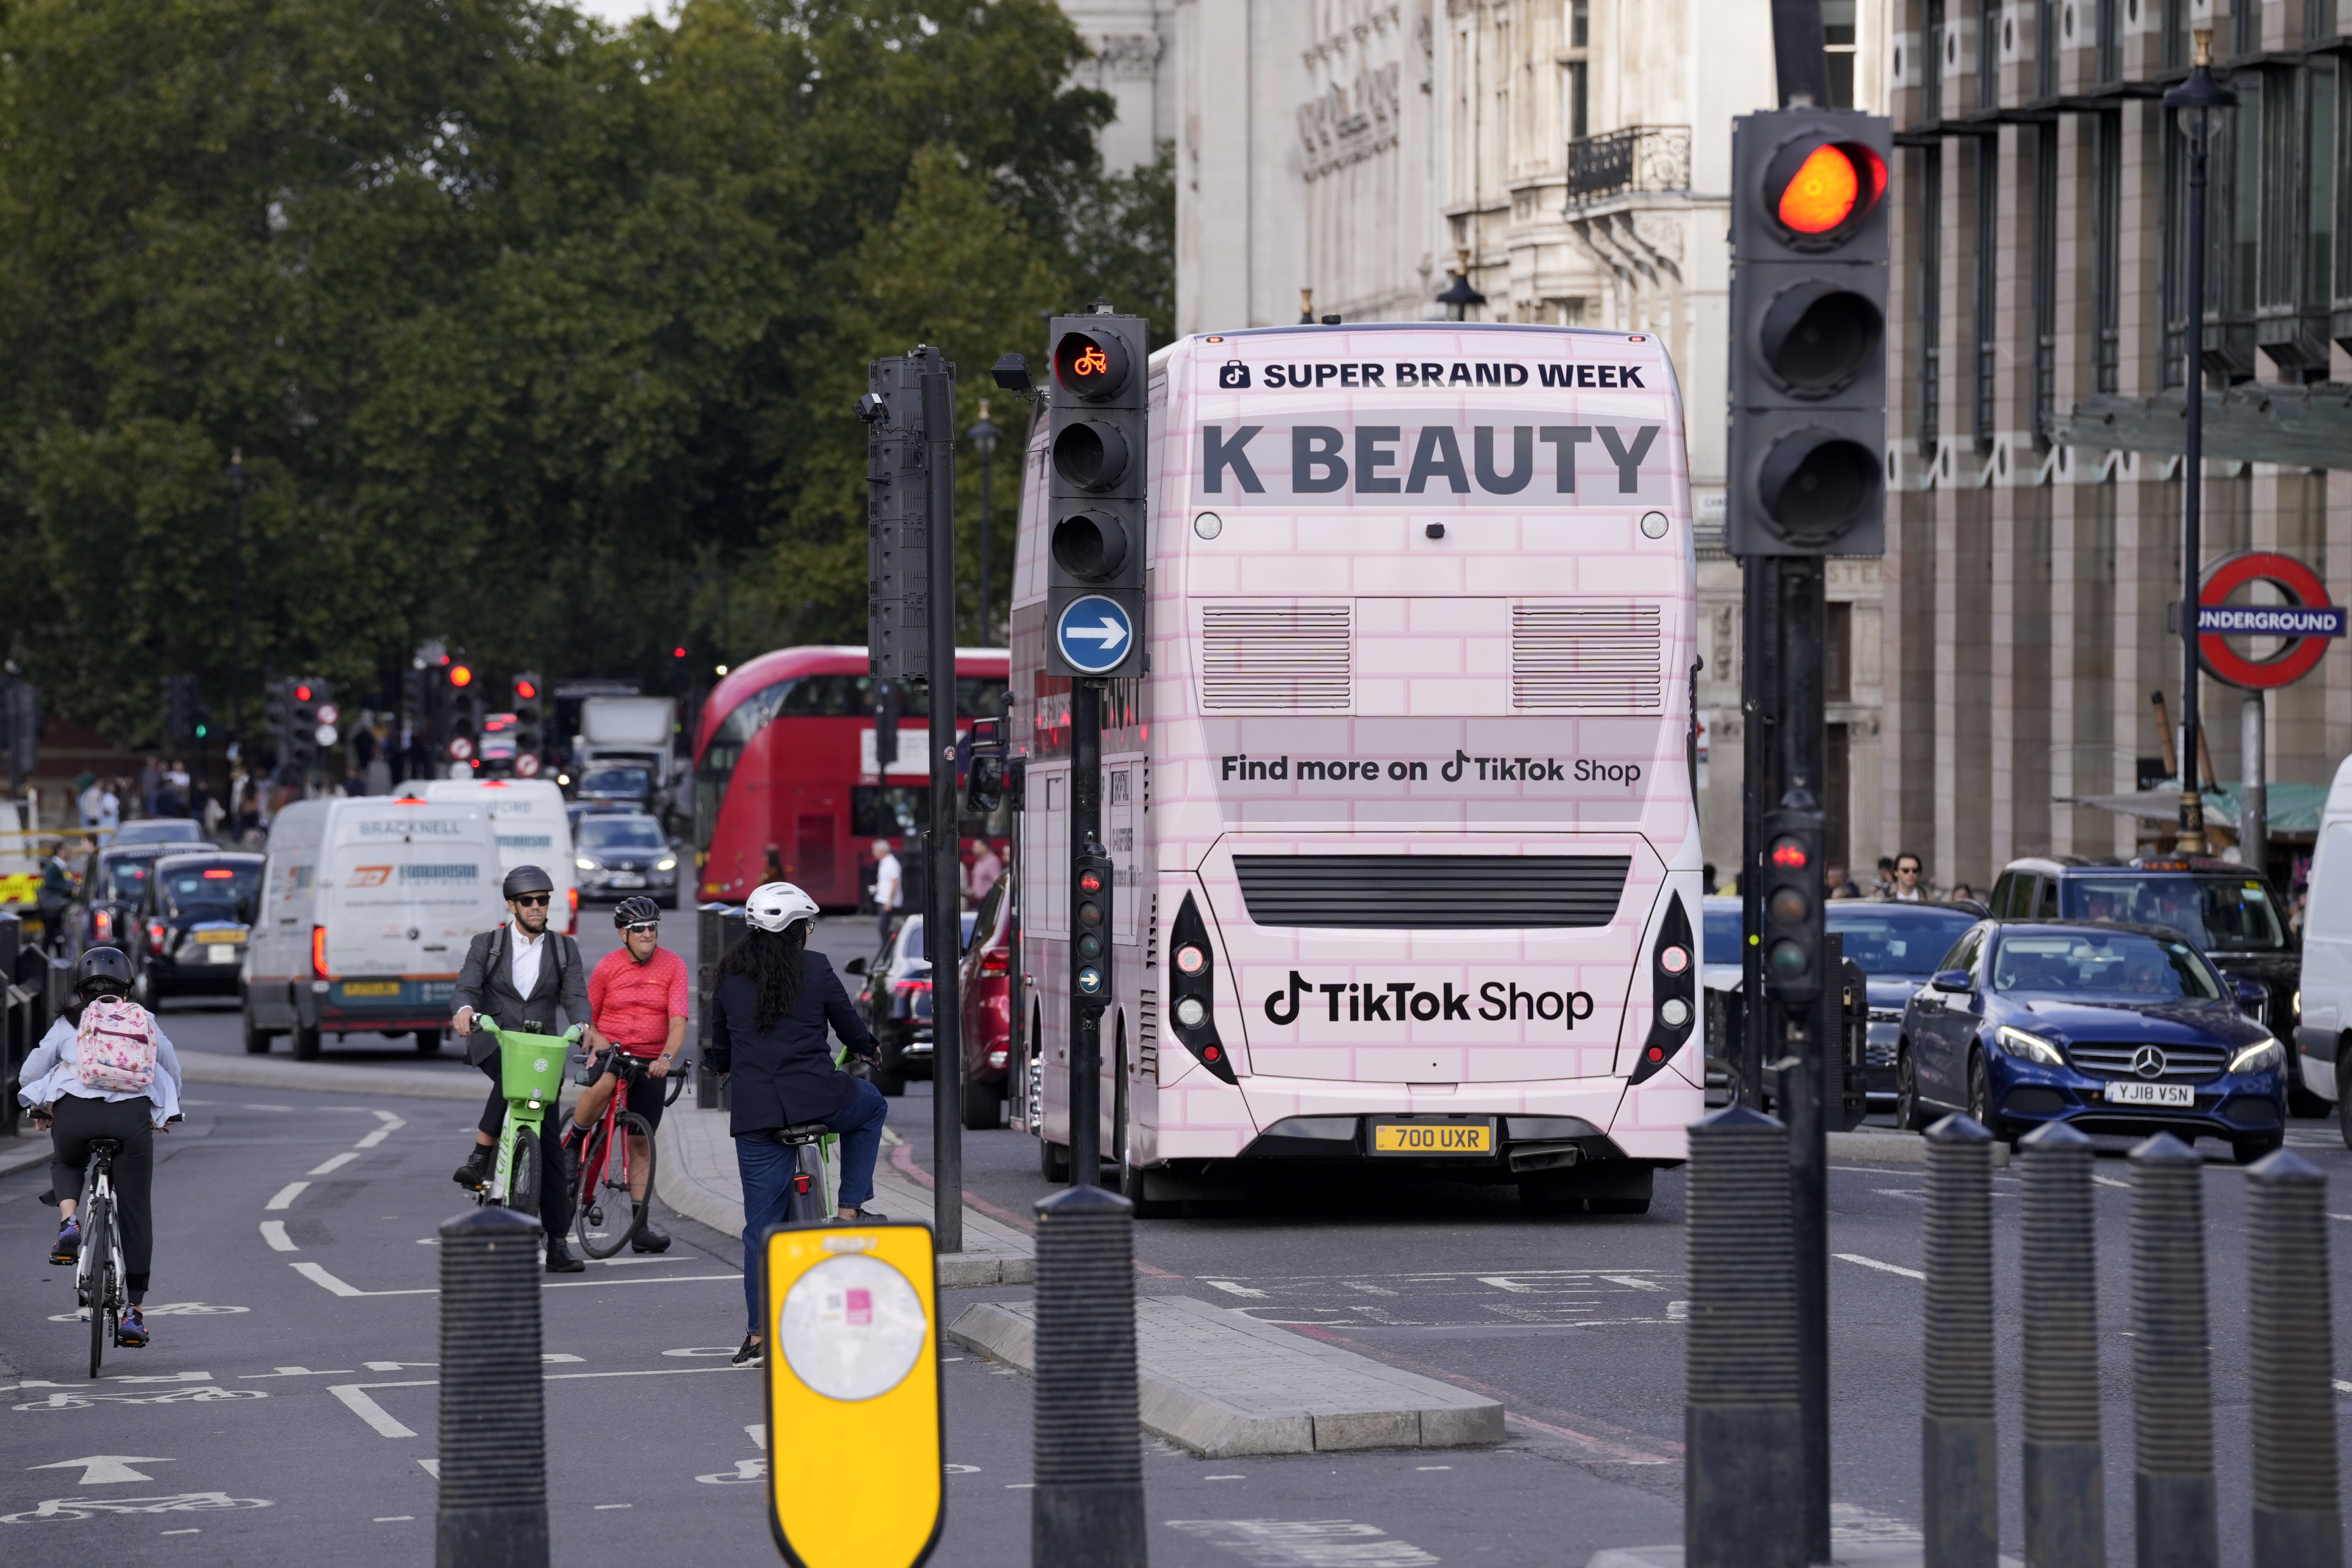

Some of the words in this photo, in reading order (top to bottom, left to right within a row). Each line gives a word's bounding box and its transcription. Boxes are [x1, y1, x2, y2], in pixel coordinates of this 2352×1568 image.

[1263, 363, 1385, 388] SUPER
[1396, 362, 1528, 388] BRAND
[1538, 364, 1645, 389] WEEK
[1203, 426, 1266, 494] K
[1292, 425, 1661, 495] BEAUTY
[1222, 755, 1288, 781] Find
[1297, 761, 1379, 781] more
[1388, 761, 1428, 781] on
[1474, 758, 1564, 781] TikTok
[1574, 759, 1641, 787] Shop
[359, 821, 462, 835] BRACKNELL
[1319, 982, 1471, 1021] TikTok
[1478, 981, 1594, 1030] Shop
[2120, 1085, 2153, 1099] YJ18
[2159, 1087, 2188, 1102] VSN
[1396, 1129, 1434, 1147] 700
[1441, 1129, 1479, 1148] UXR
